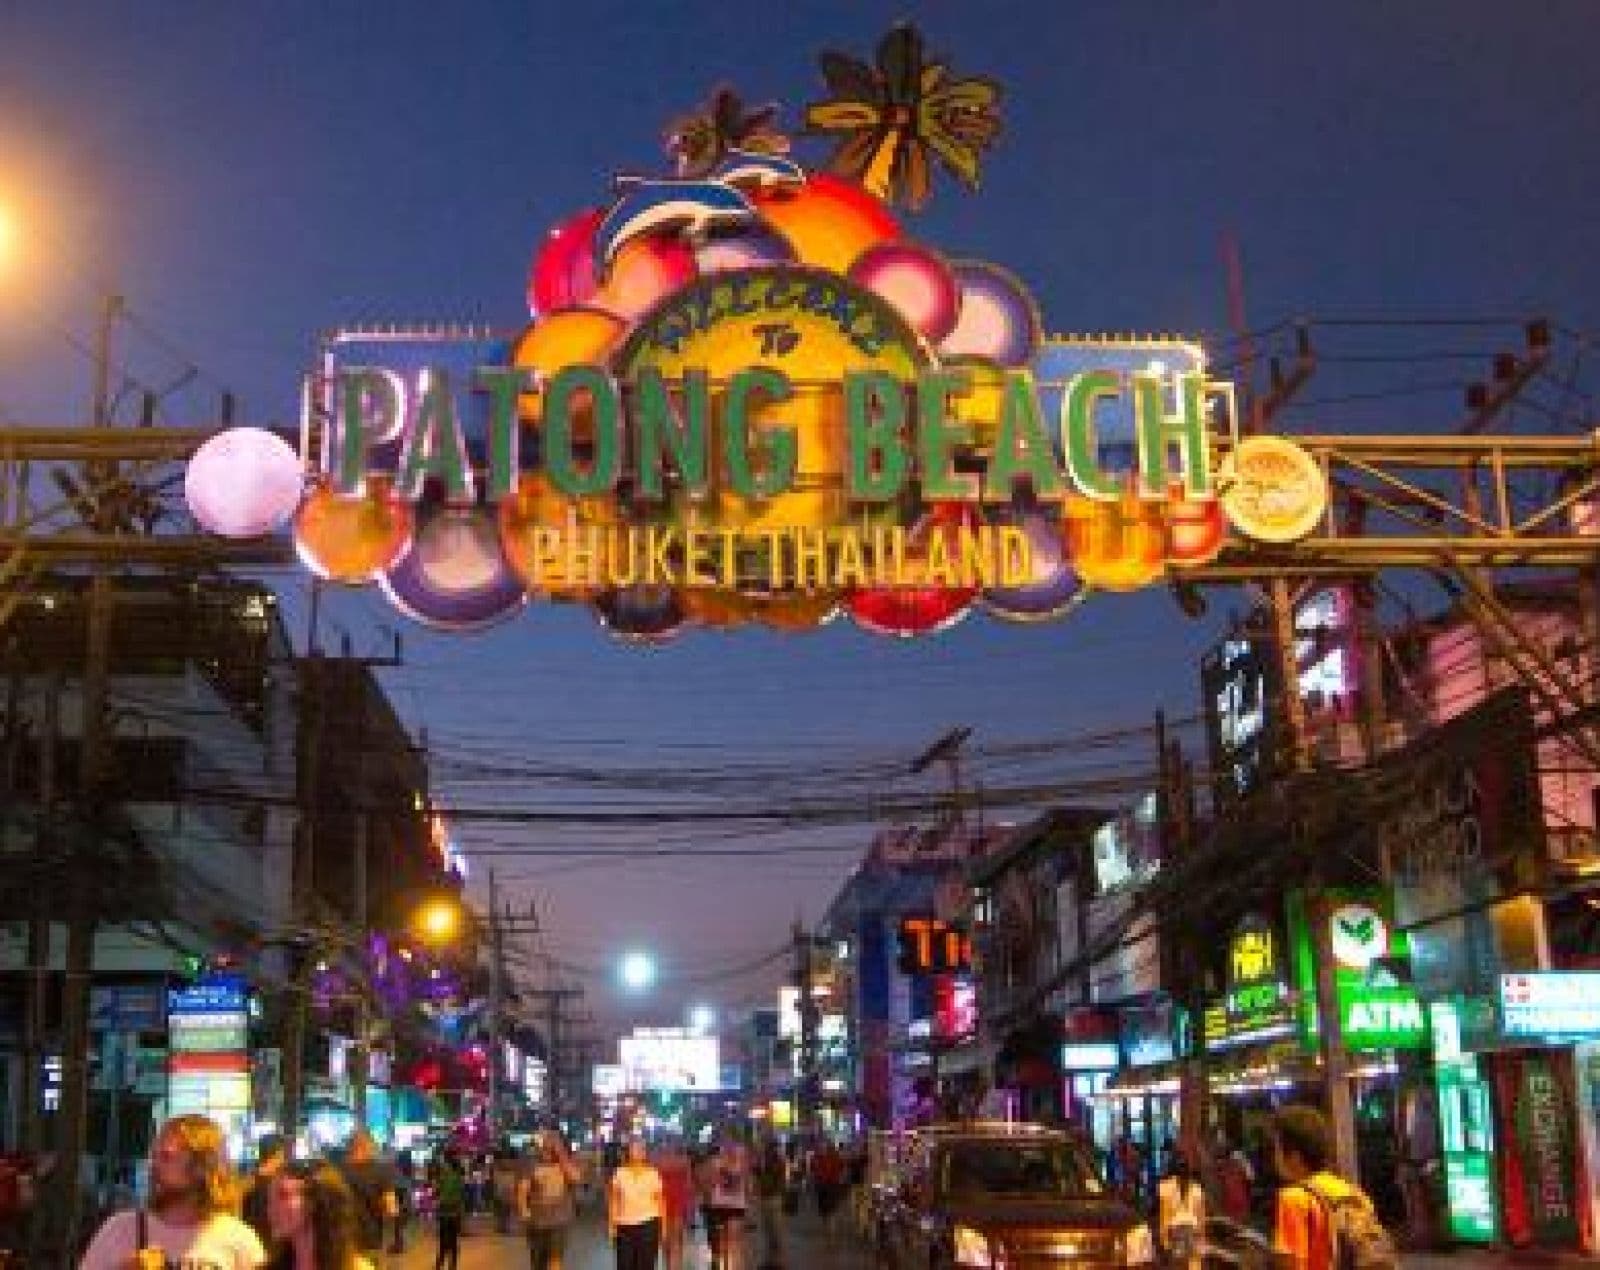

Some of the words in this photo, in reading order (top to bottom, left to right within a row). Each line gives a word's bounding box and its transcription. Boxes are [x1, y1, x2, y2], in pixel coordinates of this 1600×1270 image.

[336, 364, 796, 501] PATONG
[842, 366, 1216, 501] BEACH
[532, 523, 737, 588] PHUKET
[763, 522, 1033, 588] THAILAND
[1348, 1000, 1425, 1033] ATM
